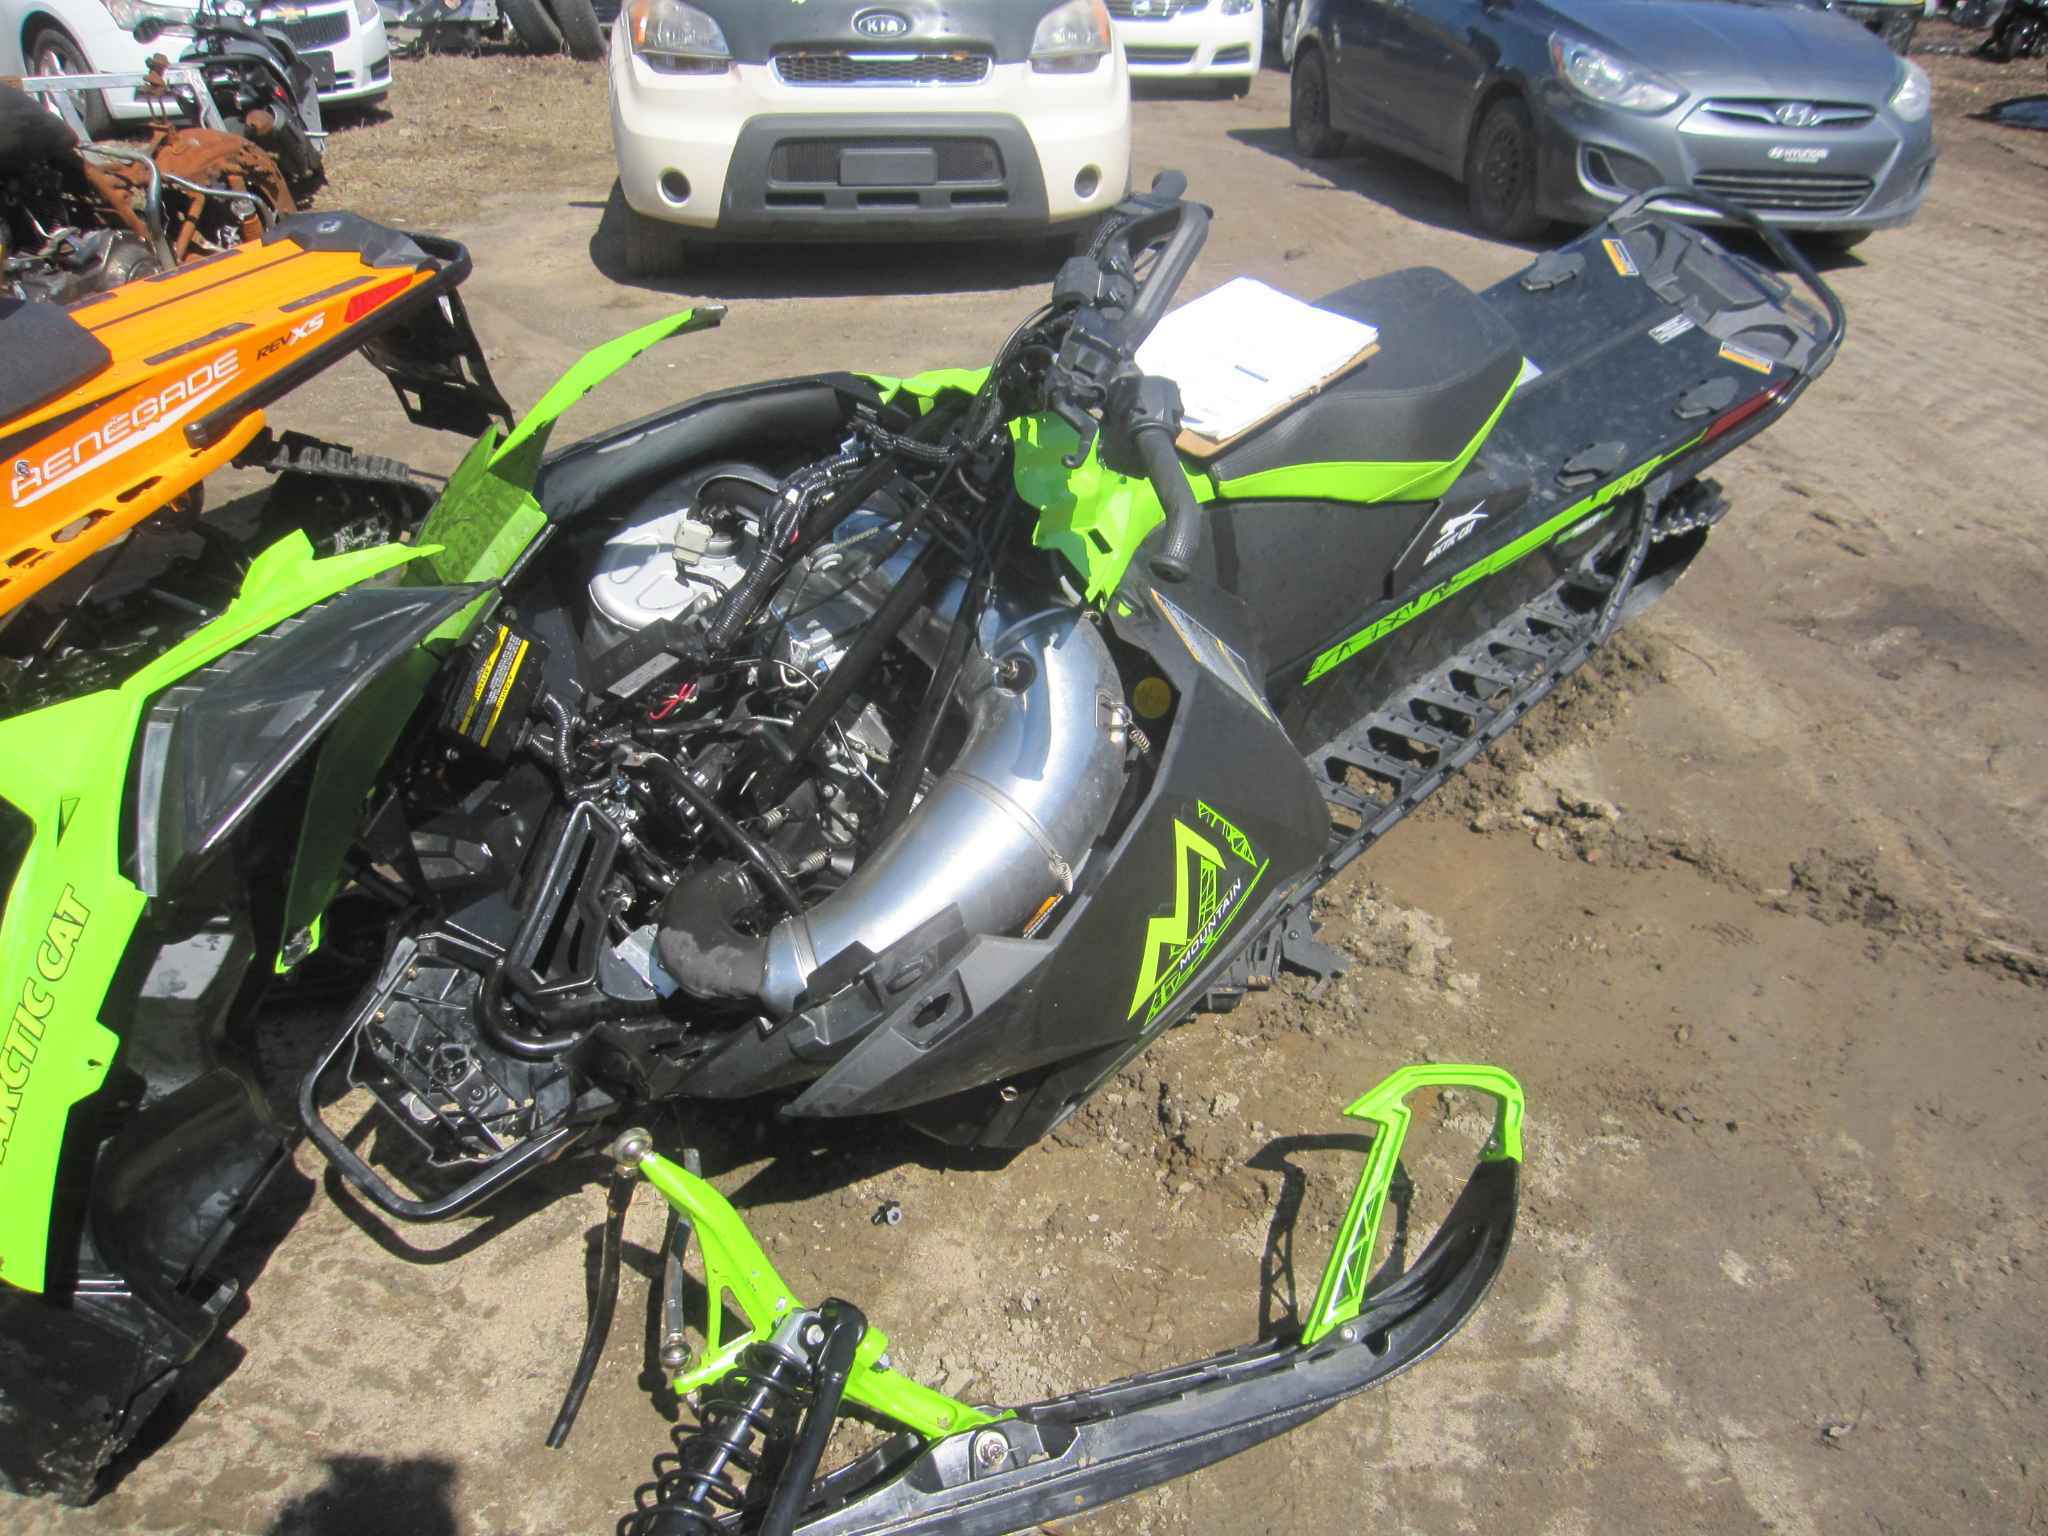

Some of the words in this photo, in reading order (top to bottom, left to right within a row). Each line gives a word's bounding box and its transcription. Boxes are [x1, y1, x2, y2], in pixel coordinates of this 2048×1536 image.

[867, 19, 898, 32] KIA
[11, 348, 240, 501] RENEGADE
[36, 882, 91, 983] CAT
[1179, 877, 1242, 971] MOUNTAIN
